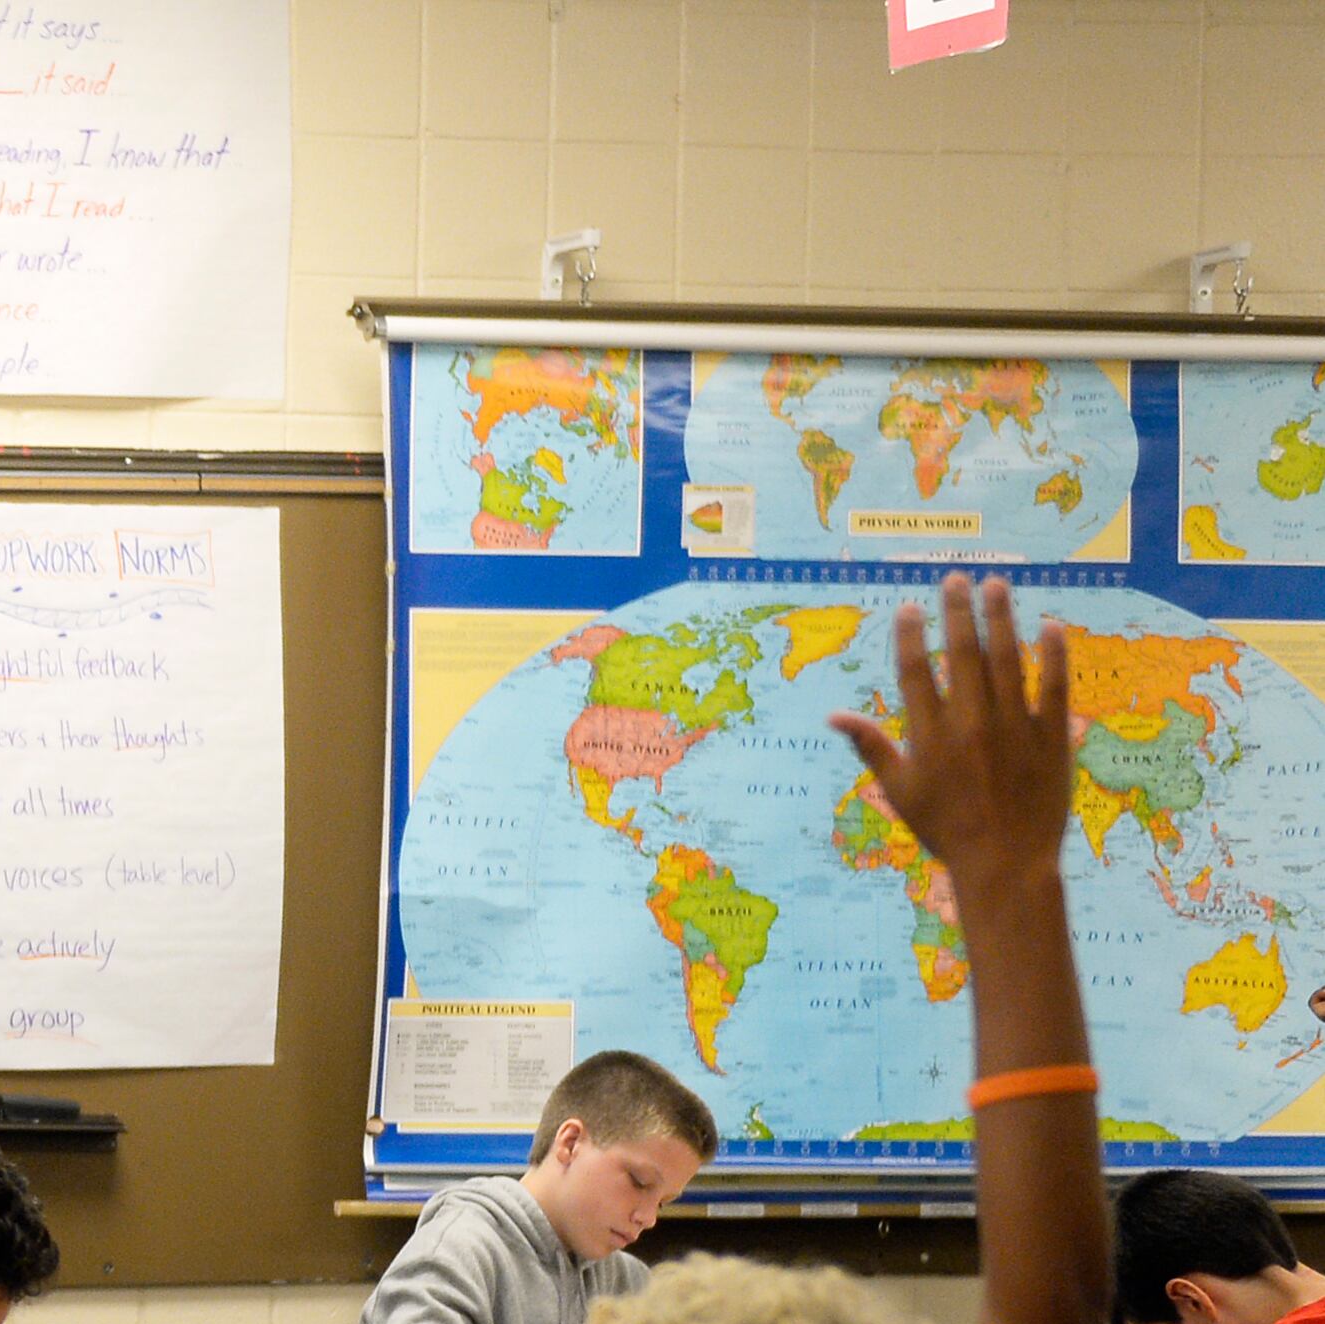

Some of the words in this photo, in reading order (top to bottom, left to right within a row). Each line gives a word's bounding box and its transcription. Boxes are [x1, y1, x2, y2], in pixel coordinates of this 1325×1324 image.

[13, 8, 34, 39] it
[33, 61, 56, 95] it
[73, 129, 100, 167] I
[106, 132, 165, 170] know
[40, 181, 66, 218] I
[859, 517, 918, 530] PHYSICAL
[925, 518, 972, 530] WORLD
[76, 648, 169, 680] feedback
[631, 681, 699, 695] CANADA
[60, 720, 101, 748] their
[114, 717, 205, 761] thoughts
[738, 738, 831, 751] ATLANTIC
[583, 741, 623, 752] UNITED
[632, 745, 672, 756] STATES
[1112, 754, 1162, 765] CHINA
[747, 784, 810, 798] OCEAN
[13, 784, 47, 817] all
[58, 787, 114, 817] times
[429, 813, 520, 828] PACIFIC
[1285, 826, 1321, 838] OCE
[3, 861, 83, 891] voices
[438, 864, 509, 877] OCEAN
[709, 907, 753, 917] BRAZIL
[1072, 931, 1145, 944] NDIAN
[17, 929, 116, 972] actively
[794, 960, 886, 972] ATLANTIC
[1091, 975, 1134, 987] EAN
[1193, 976, 1276, 990] AUSTRALIA
[422, 1003, 482, 1016] POLITICAL
[487, 1005, 536, 1015] LEGEND
[808, 998, 873, 1010] OCEAN
[9, 1006, 86, 1039] group
